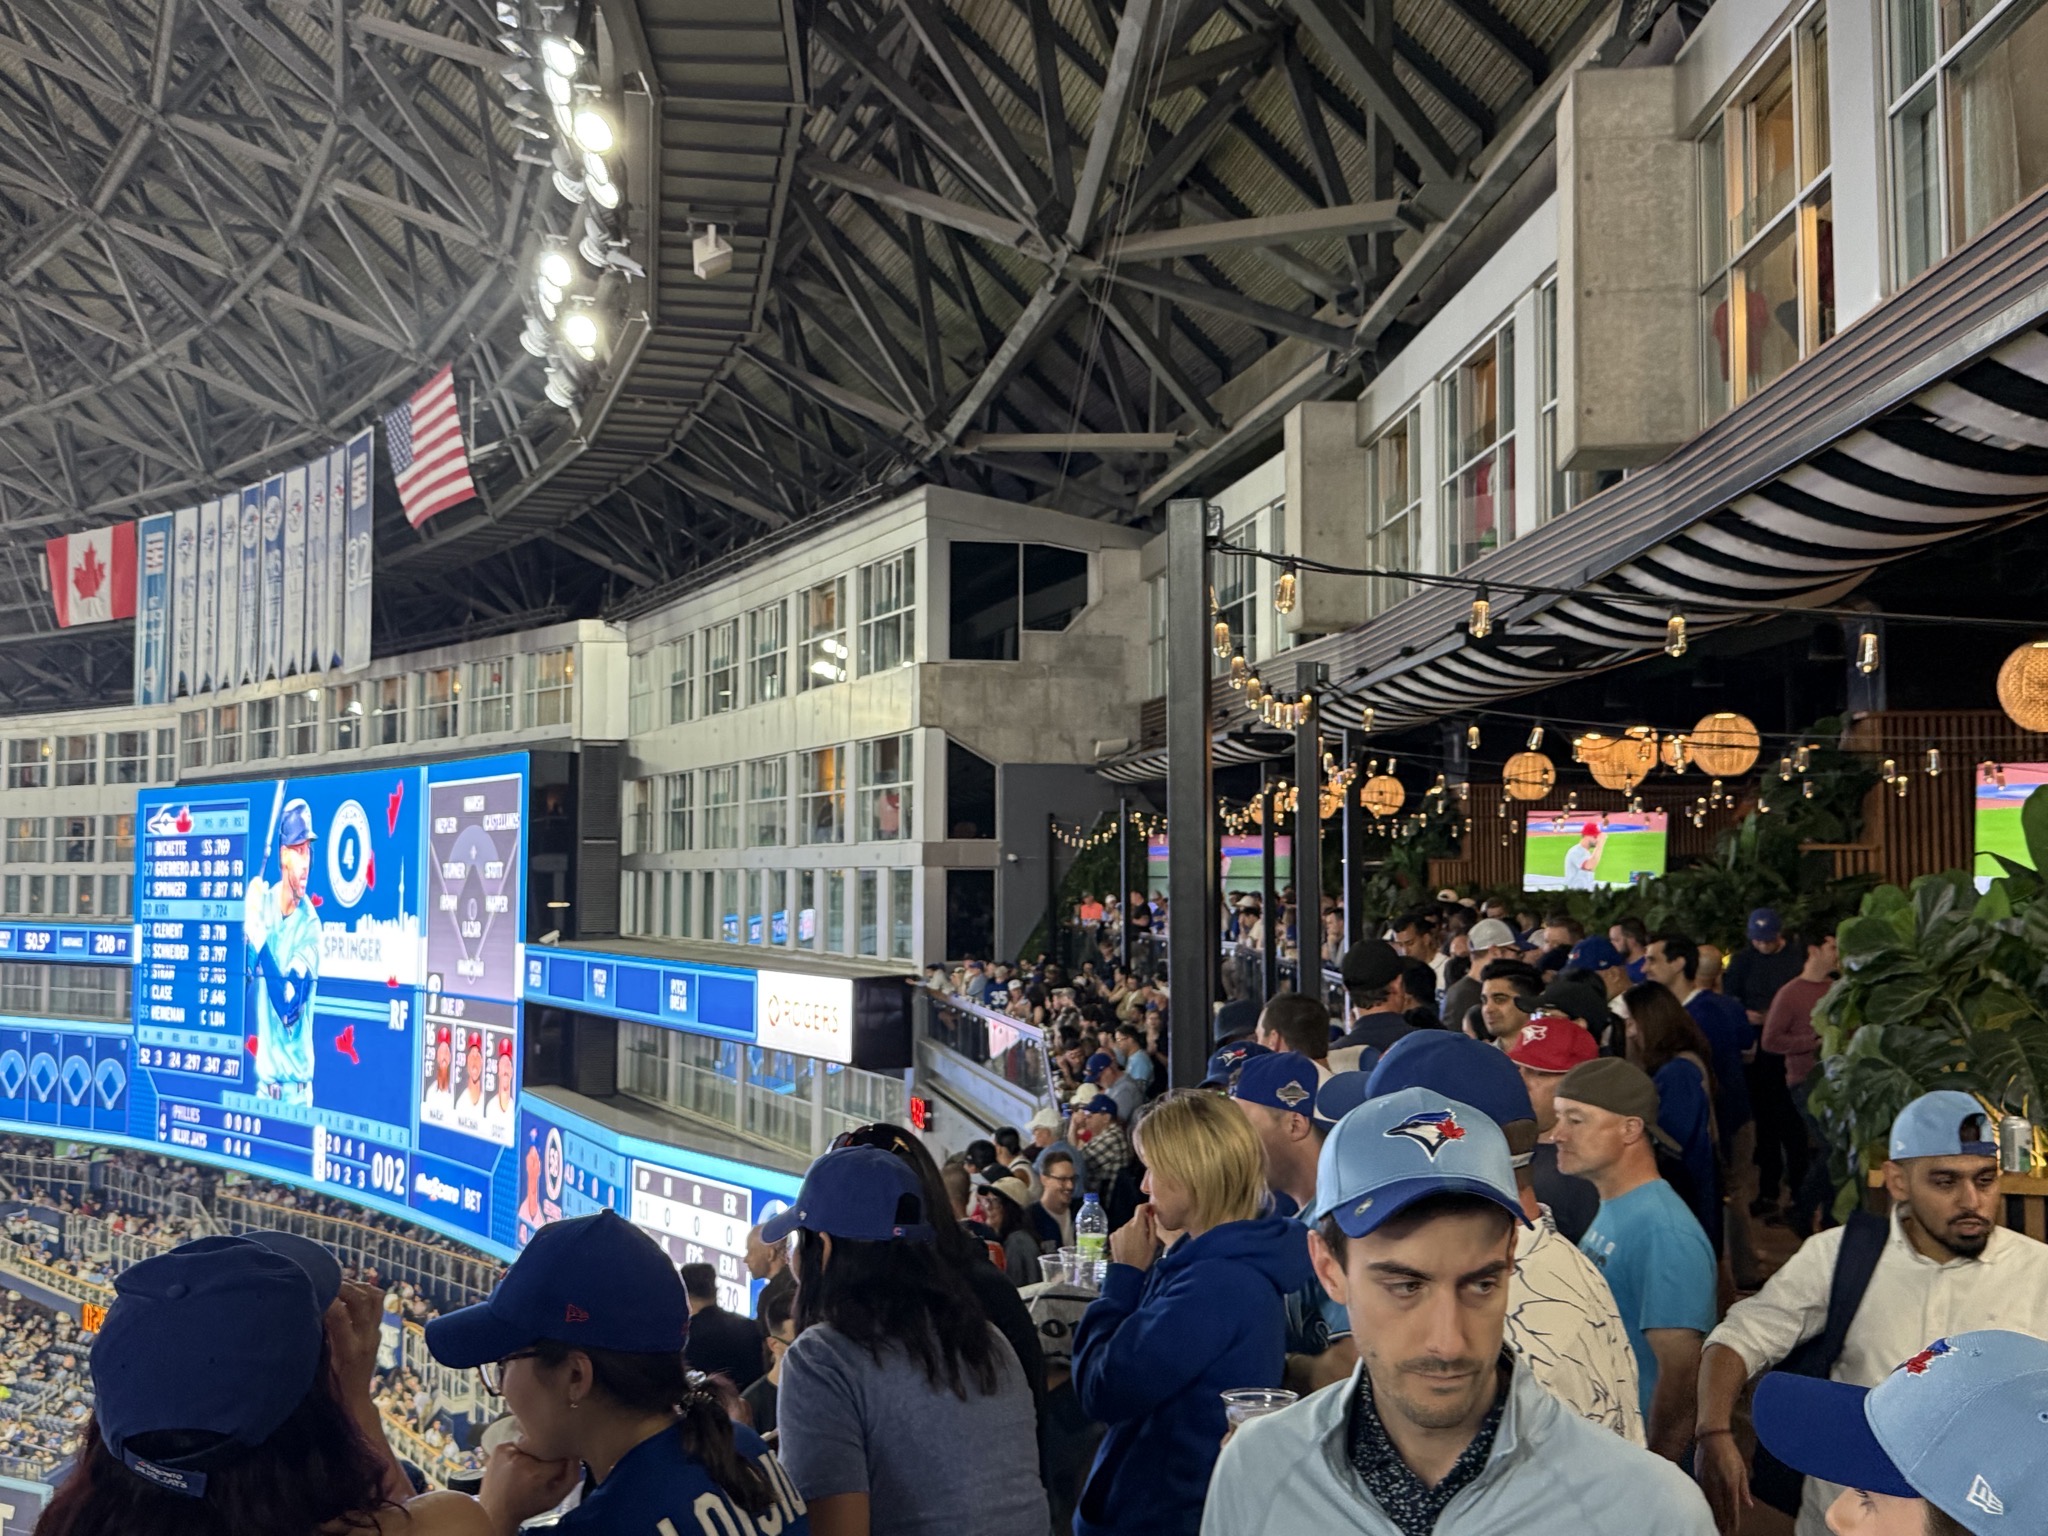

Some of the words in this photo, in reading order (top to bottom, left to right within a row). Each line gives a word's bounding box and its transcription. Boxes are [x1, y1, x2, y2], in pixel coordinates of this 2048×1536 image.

[347, 531, 372, 592] 32
[342, 838, 354, 870] 4
[95, 934, 116, 954] 208
[152, 923, 184, 939] CLEMENT
[324, 936, 382, 963] SPRINGER
[151, 983, 174, 1001] CLASE
[990, 990, 1009, 1006] 35
[388, 999, 409, 1031] RF
[783, 1000, 839, 1034] ROGERS
[426, 1022, 436, 1046] 16
[456, 1026, 467, 1052] 13
[485, 1031, 495, 1058] 5
[154, 1049, 163, 1067] 3
[168, 1051, 181, 1069] 24
[172, 1104, 201, 1124] PHILLIES
[171, 1127, 190, 1145] BLUE
[190, 1131, 208, 1149] JAYS
[464, 1187, 482, 1213] BET
[663, 1176, 672, 1198] H
[692, 1184, 702, 1206] R
[723, 1192, 737, 1217] ER
[664, 1206, 671, 1228] 0
[694, 1215, 700, 1237] 0
[725, 1225, 733, 1247] 0
[719, 1253, 738, 1280] ERA
